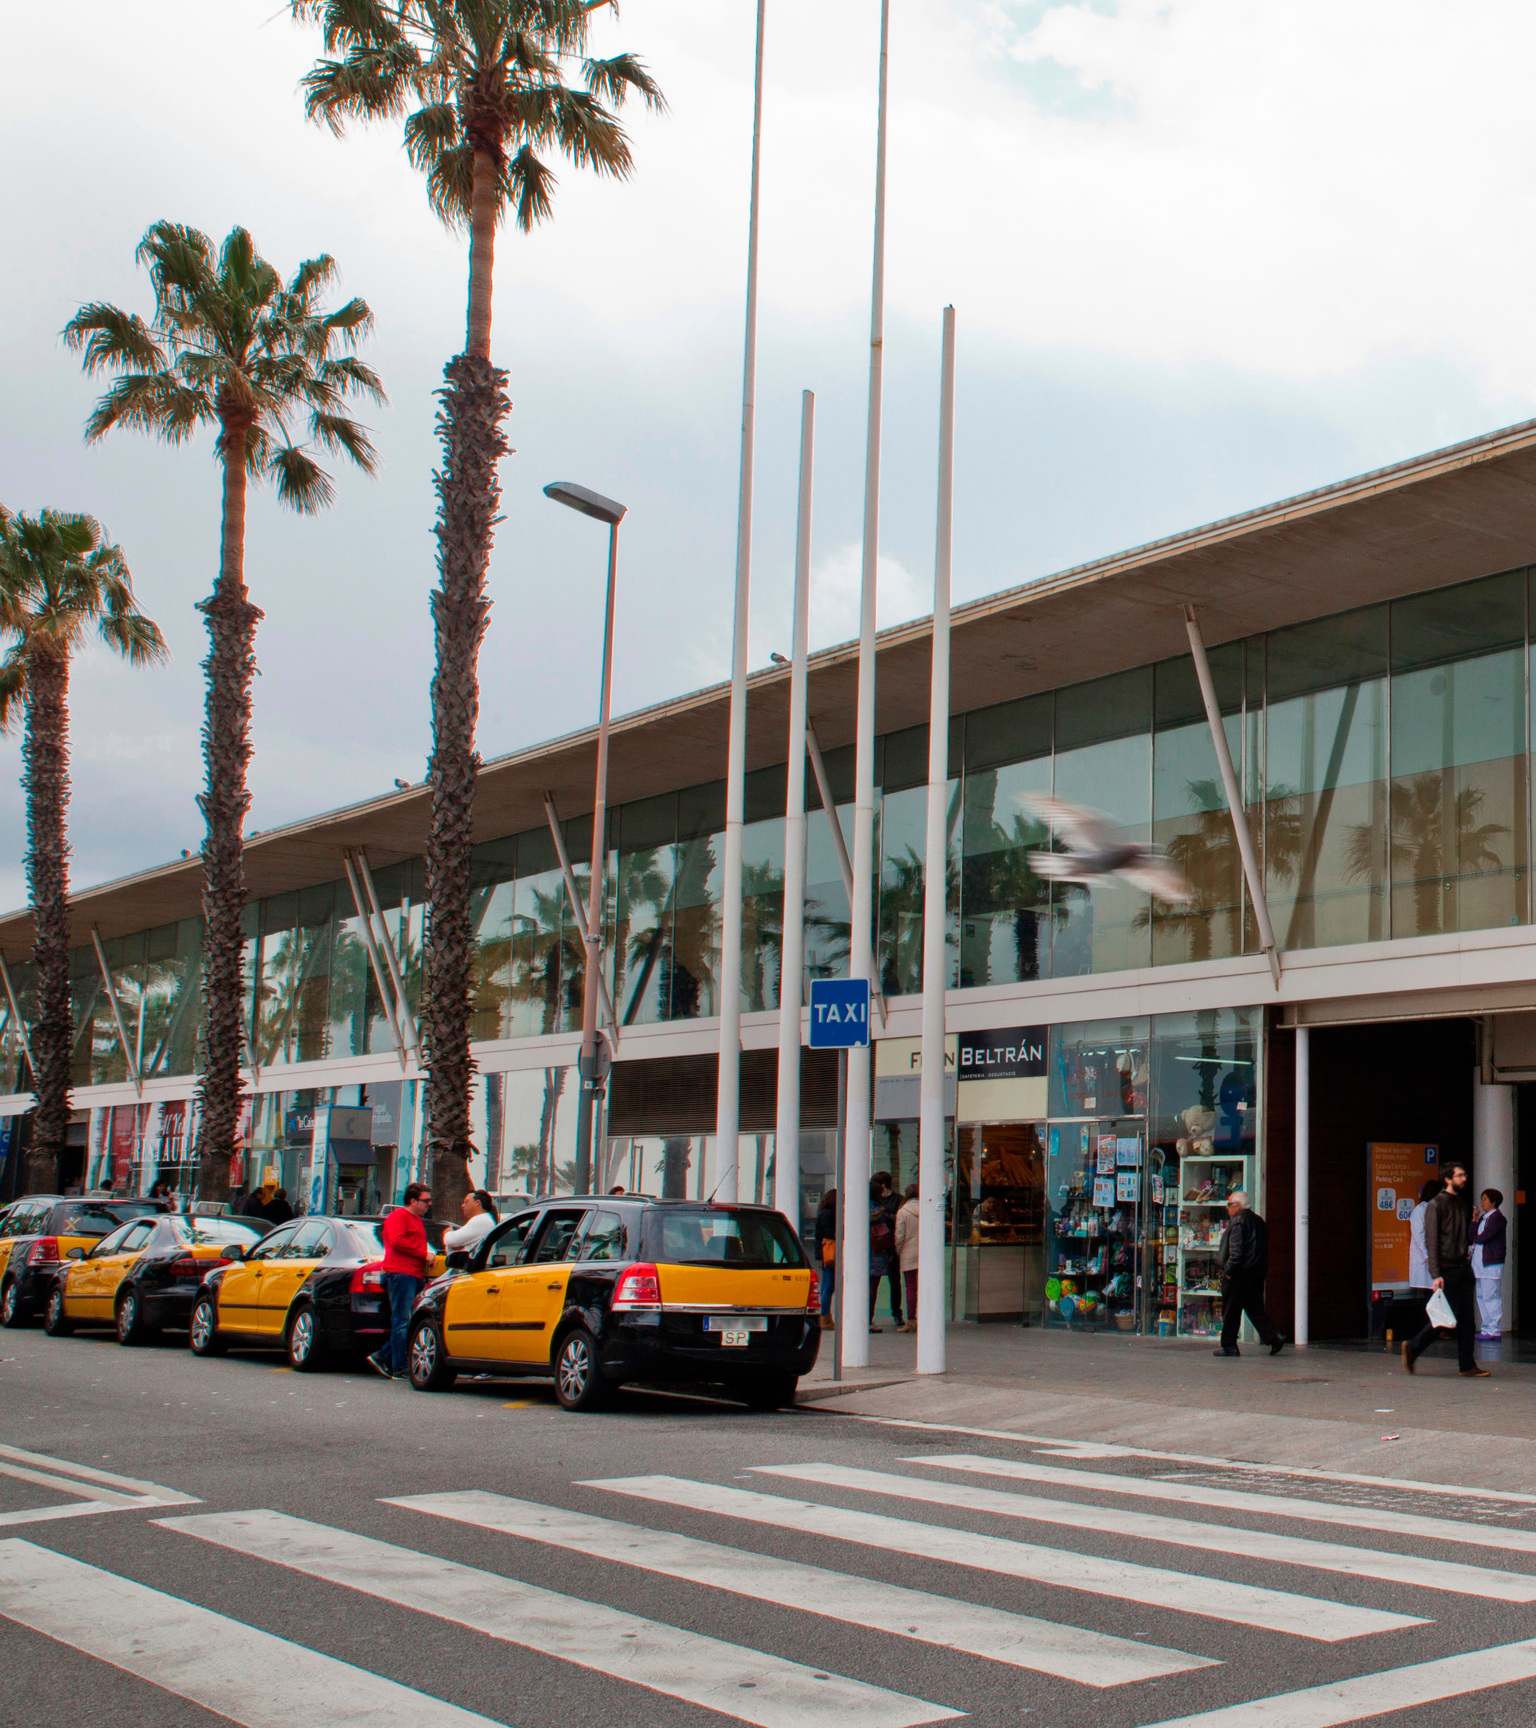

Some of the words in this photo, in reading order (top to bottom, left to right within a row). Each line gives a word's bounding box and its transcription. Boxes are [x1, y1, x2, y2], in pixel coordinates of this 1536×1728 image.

[813, 1002, 866, 1023] TAXI
[910, 1051, 955, 1069] FN
[961, 1039, 1042, 1066] BELTRÁN
[1427, 1148, 1435, 1163] P
[1379, 1200, 1393, 1209] 48€
[725, 1332, 747, 1344] SP
